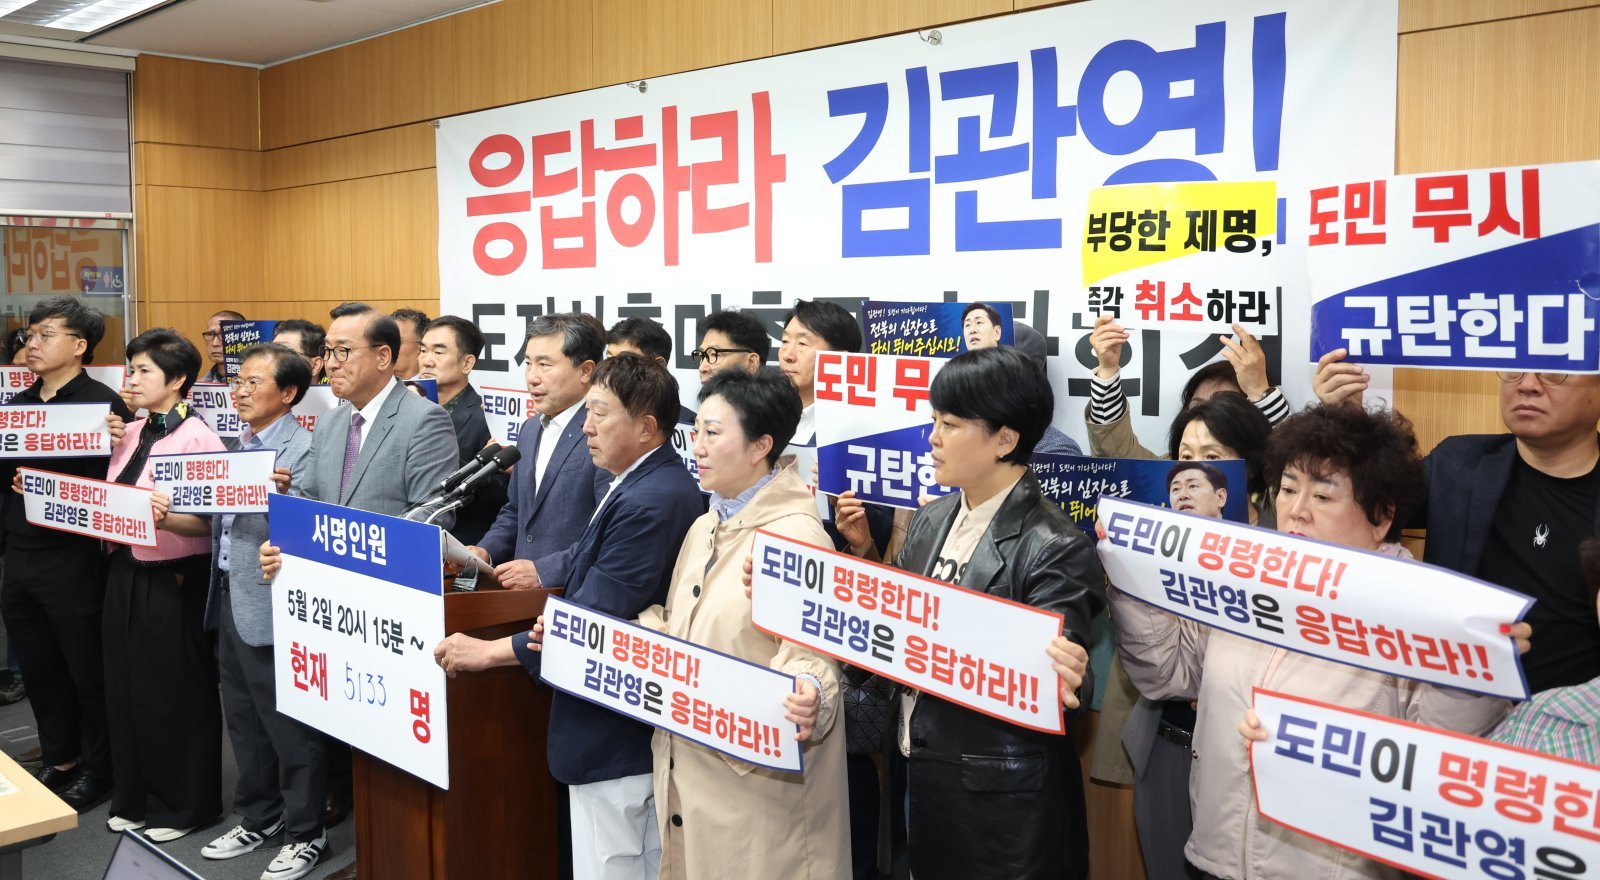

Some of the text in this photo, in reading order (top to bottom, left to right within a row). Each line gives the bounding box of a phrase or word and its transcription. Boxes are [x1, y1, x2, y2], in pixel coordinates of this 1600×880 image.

[466, 12, 1287, 276] 응답하라 김관영!
[1087, 209, 1272, 257] 부당한 제명,
[1308, 169, 1541, 246] 도민 무시
[870, 319, 938, 338] 전북의 심장으로
[1087, 280, 1270, 326] 즉각 취소하라
[1341, 293, 1595, 361] 규탄한다
[870, 339, 891, 355] 다시
[192, 391, 228, 409] 도민이
[483, 394, 520, 417] 도민이
[815, 354, 931, 412] 도민 무
[24, 432, 102, 452] 응답하라!!
[217, 413, 249, 431] 김관
[24, 474, 108, 507] 도민이 명령한다!
[154, 459, 229, 482] 도민이 명령한다!
[172, 484, 270, 507] 김관영은 응답하라!!
[846, 444, 951, 503] 규탄한
[44, 501, 148, 540] 김관영은 응답하라!!
[312, 514, 387, 566] 서명인원
[1107, 512, 1348, 600] 도민이 명령한다!
[761, 544, 824, 594] 도민이
[833, 565, 941, 632] 명령한다!
[288, 589, 308, 623] 5월
[312, 596, 333, 632] 2일
[337, 604, 367, 644] 20시
[373, 616, 404, 656] 15분
[550, 607, 701, 688] 도민이 명령한다!
[1159, 569, 1495, 682] 김관영은 응답하라!!
[801, 599, 1040, 714] 김관영은 응답하라!!
[290, 641, 431, 745] 현재 5133 명
[583, 658, 782, 758] 김관영은 응답하라!!
[1275, 712, 1600, 843] 도민이 명령한
